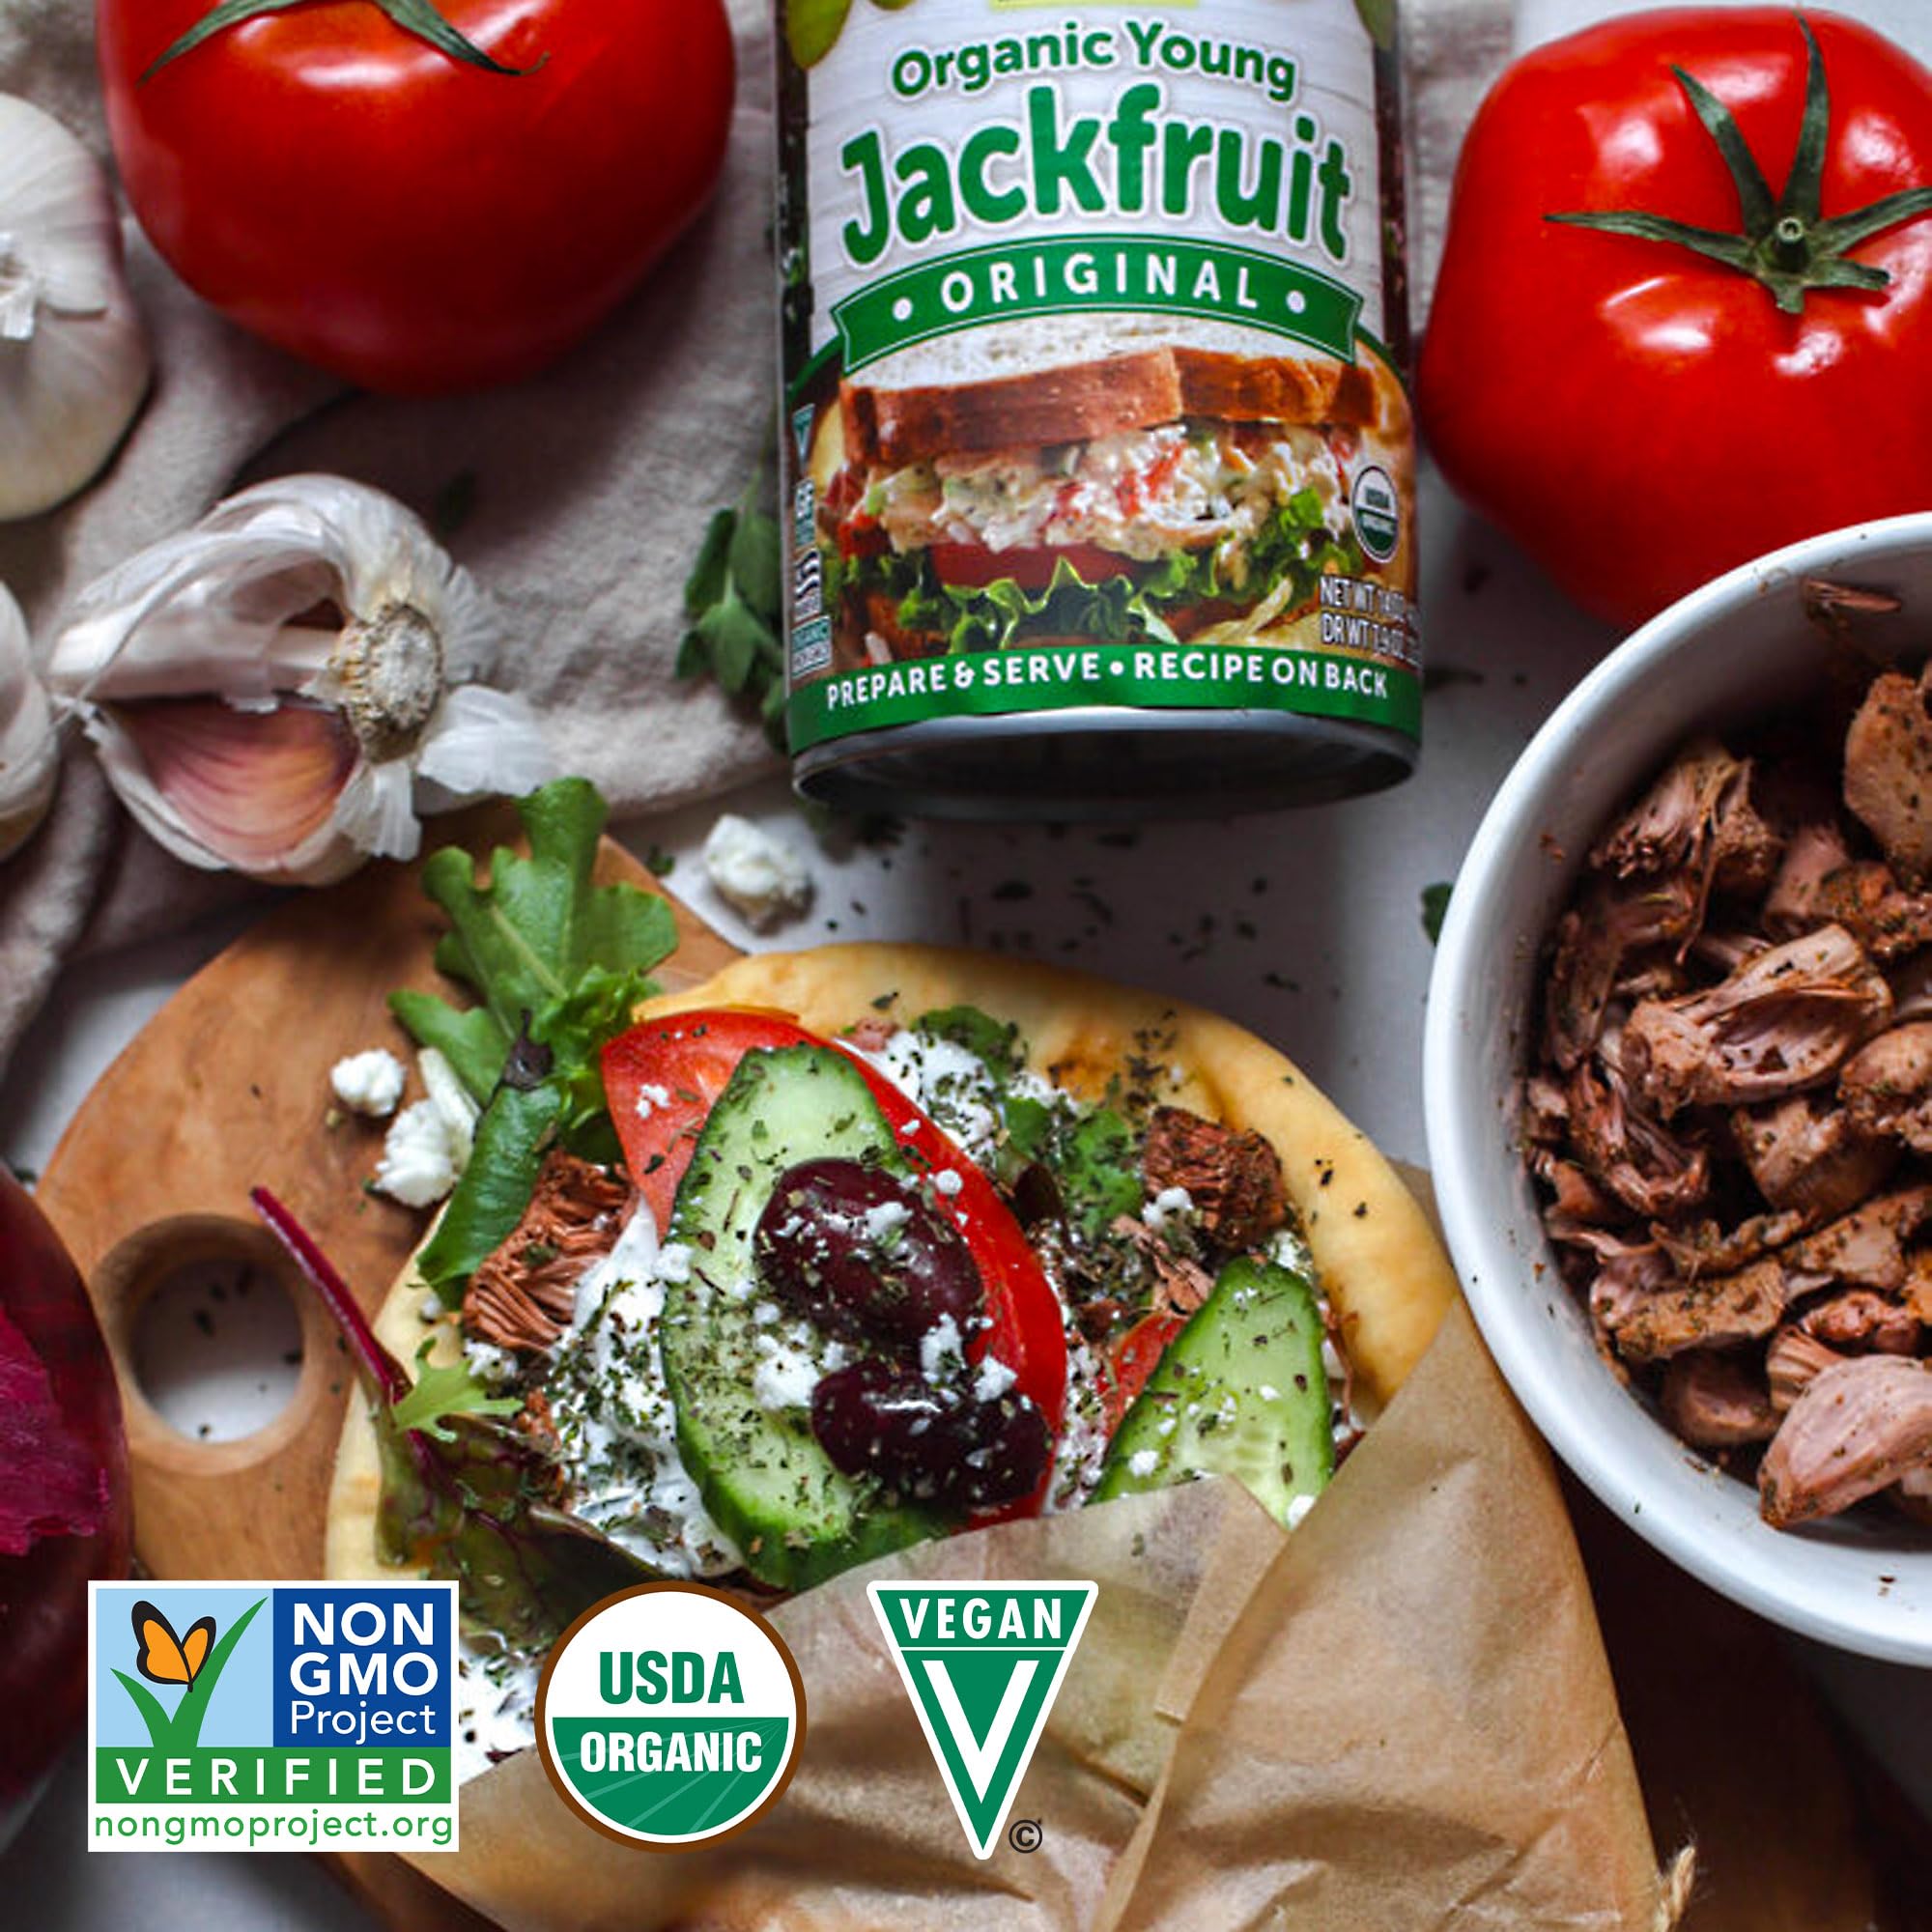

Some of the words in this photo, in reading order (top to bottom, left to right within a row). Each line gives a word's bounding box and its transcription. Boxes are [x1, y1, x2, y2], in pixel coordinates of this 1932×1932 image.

[893, 22, 1114, 97] Organic
[1125, 21, 1295, 101] Young
[841, 83, 1350, 264] Jackfruit
[941, 252, 1258, 313] ORIGINAL
[1321, 576, 1350, 609] NET
[1321, 612, 1345, 644] DR
[827, 663, 947, 711] PREPARE
[954, 662, 974, 688] &
[983, 652, 1099, 685] SERVE
[1134, 656, 1264, 682] RECIPE
[1271, 658, 1319, 687] ON
[1324, 662, 1388, 699] BACK
